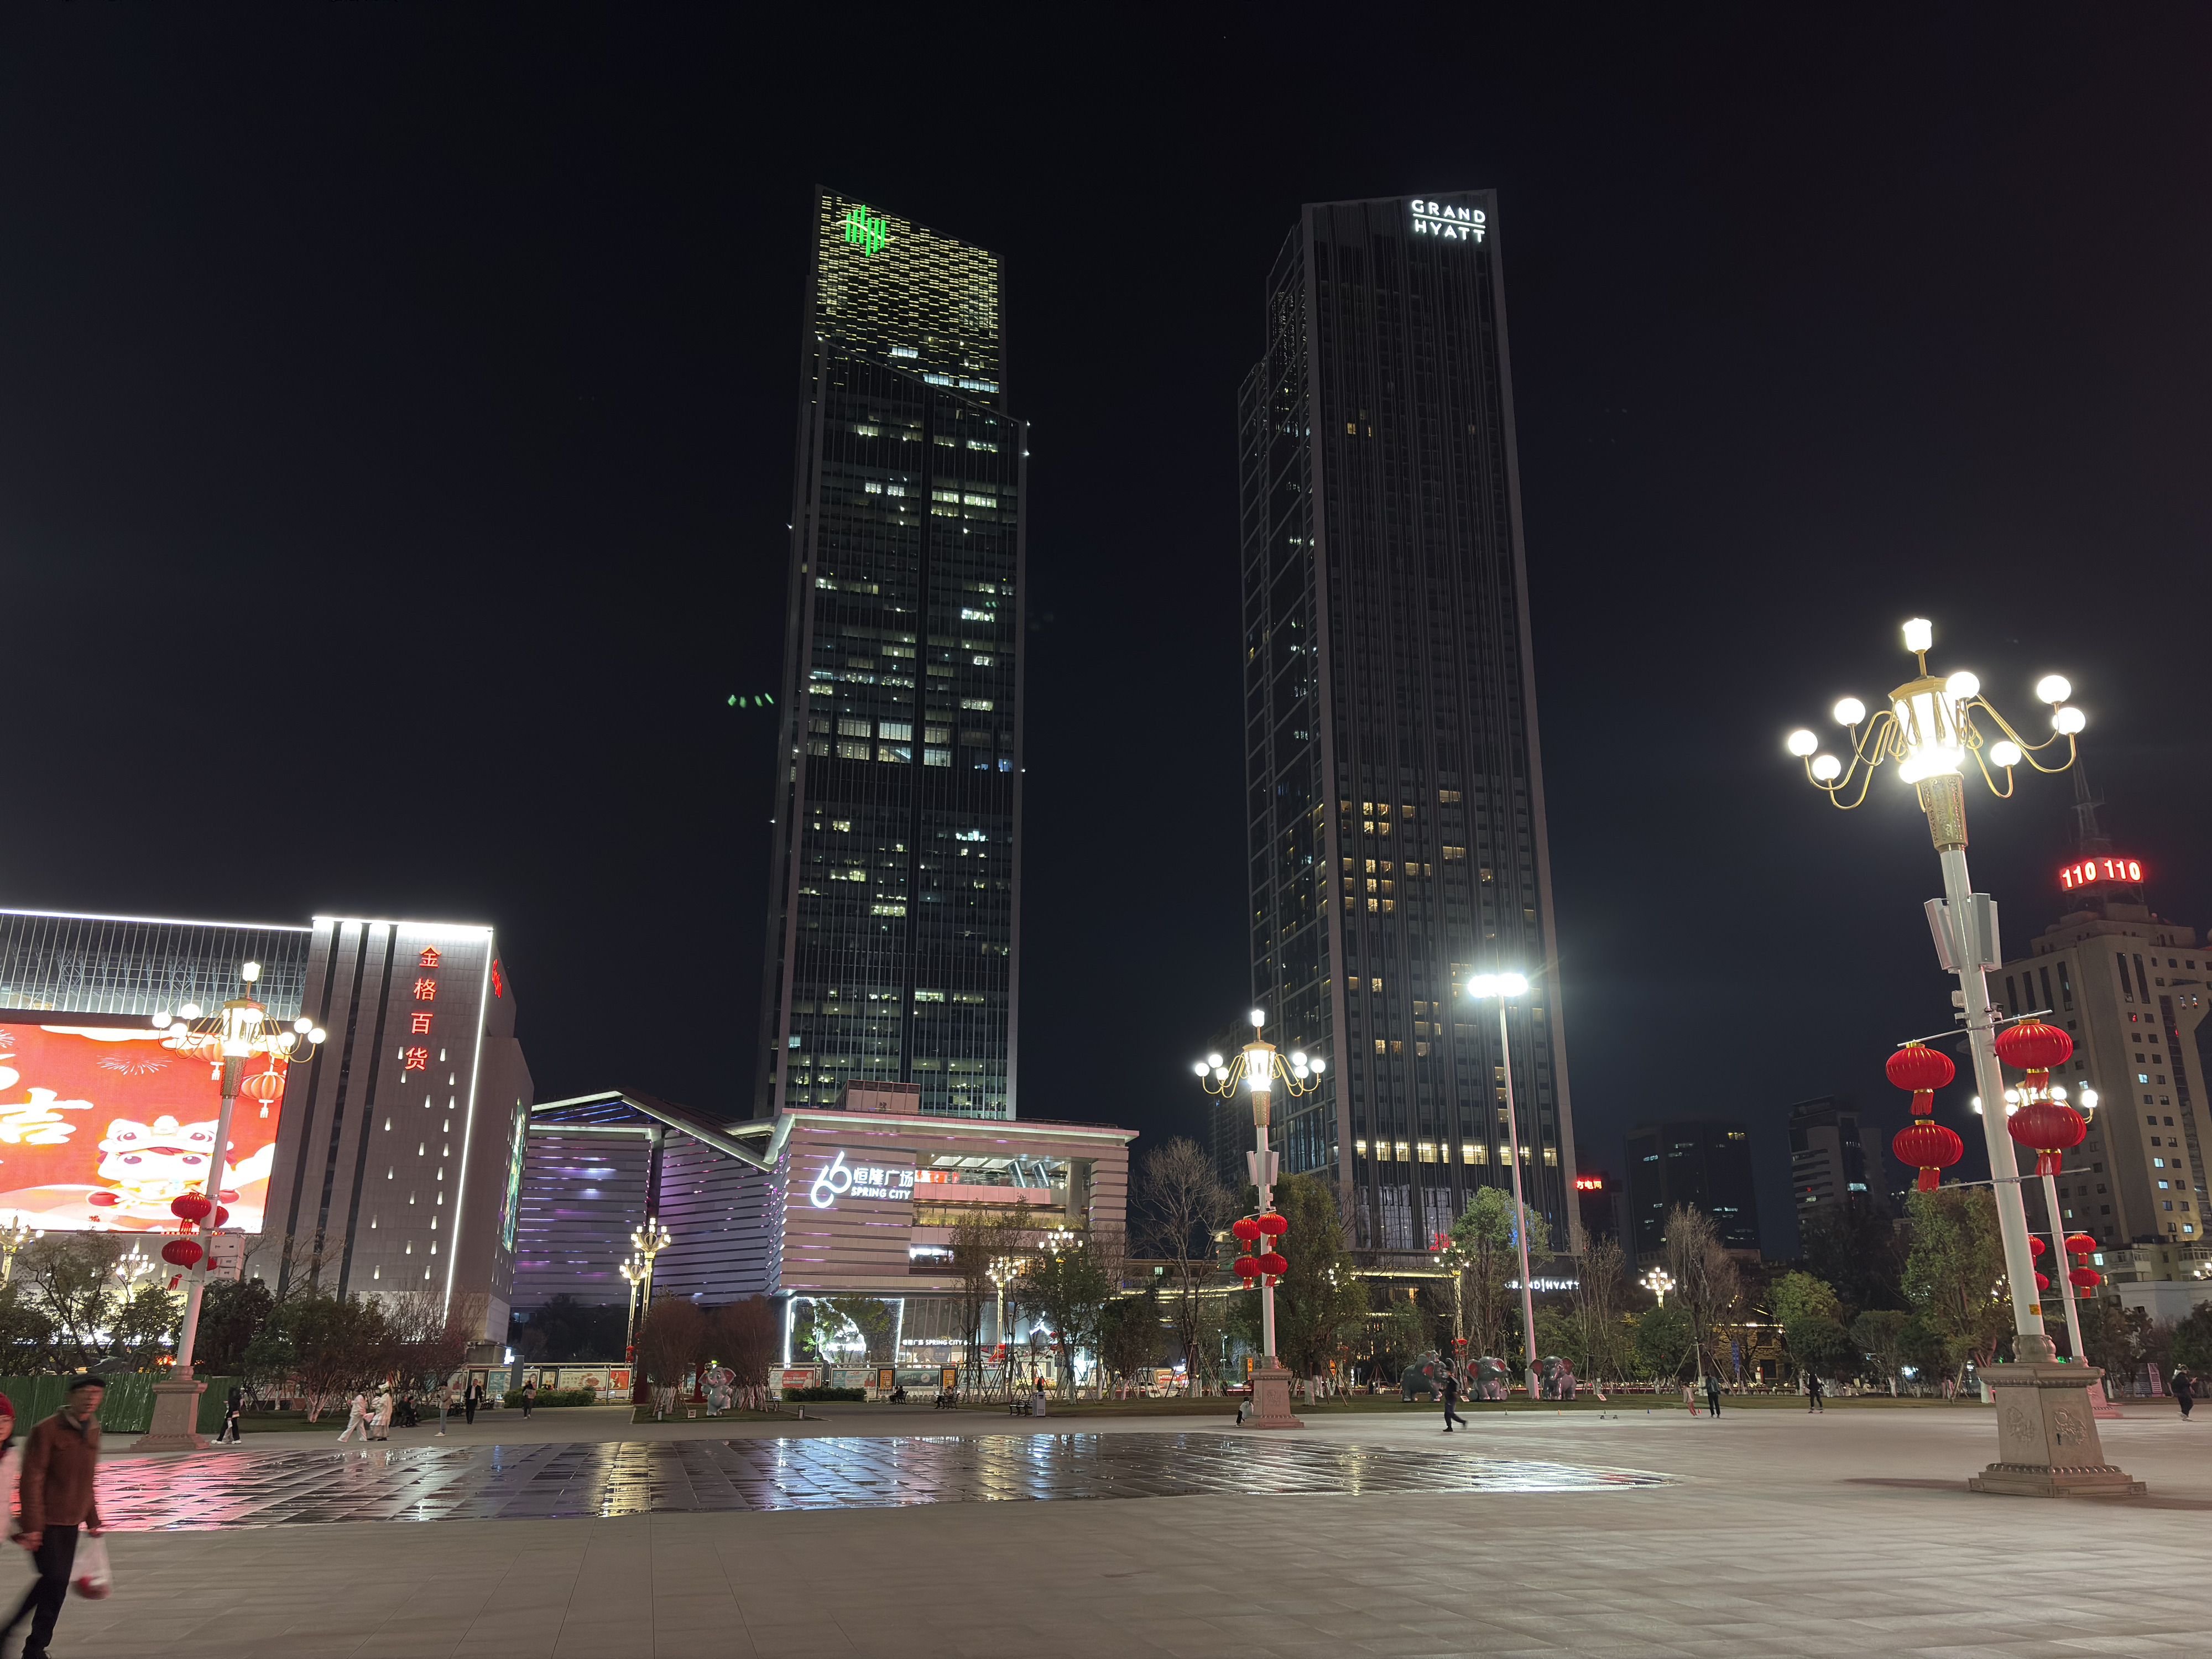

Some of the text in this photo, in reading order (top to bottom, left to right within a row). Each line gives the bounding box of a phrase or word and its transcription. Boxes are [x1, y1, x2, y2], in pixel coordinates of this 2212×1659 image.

[1412, 200, 1485, 223] GRAND
[1415, 219, 1485, 243] HYATT
[2062, 862, 2097, 888] 110
[2104, 859, 2141, 881] 110
[404, 943, 442, 1071] 金格百货
[853, 1167, 914, 1188] 恒隆广场
[851, 1186, 911, 1200] SPRING CITY
[1505, 1281, 1580, 1290] GRND HYATT
